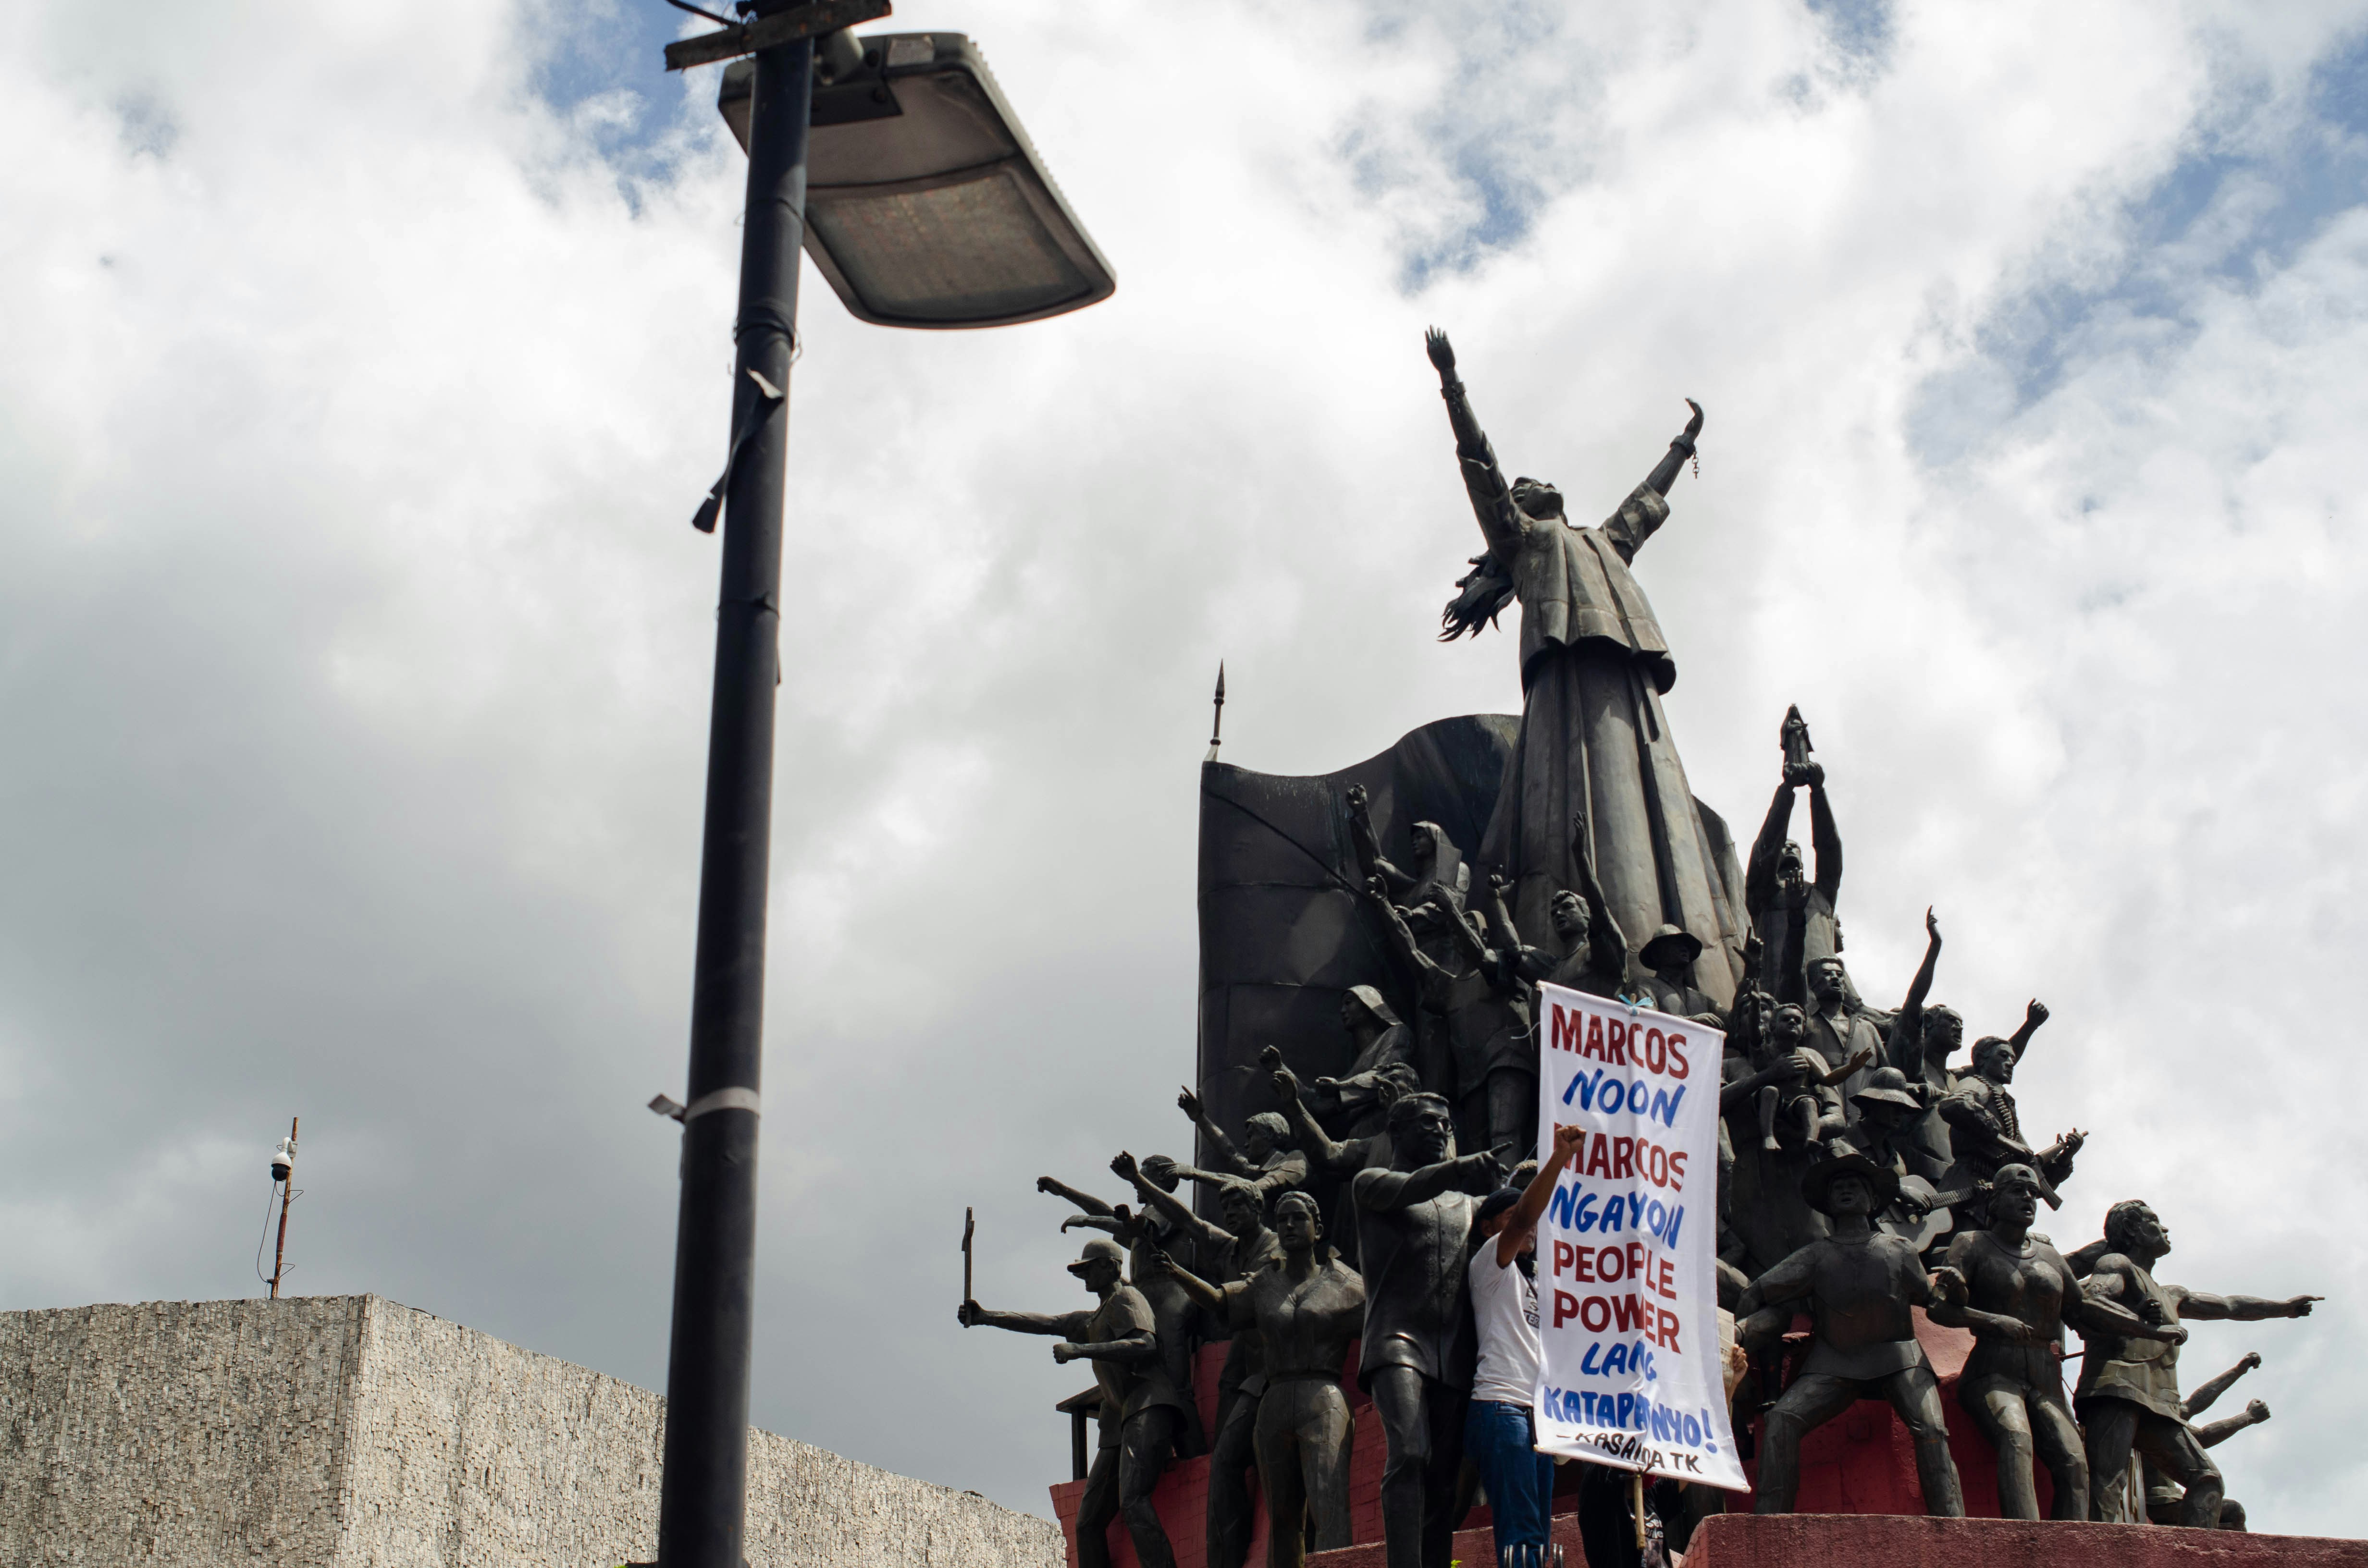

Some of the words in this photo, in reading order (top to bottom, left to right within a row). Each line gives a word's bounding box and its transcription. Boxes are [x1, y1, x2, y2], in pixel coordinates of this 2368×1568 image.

[1551, 1003, 1690, 1080] MARCOS
[1563, 1068, 1686, 1128] NOON
[1549, 1181, 1684, 1250] NGAYON
[1554, 1239, 1677, 1300] PEOPLE
[1553, 1288, 1682, 1354] POWER
[1581, 1340, 1657, 1381] LANG
[1670, 1451, 1702, 1474] TK
